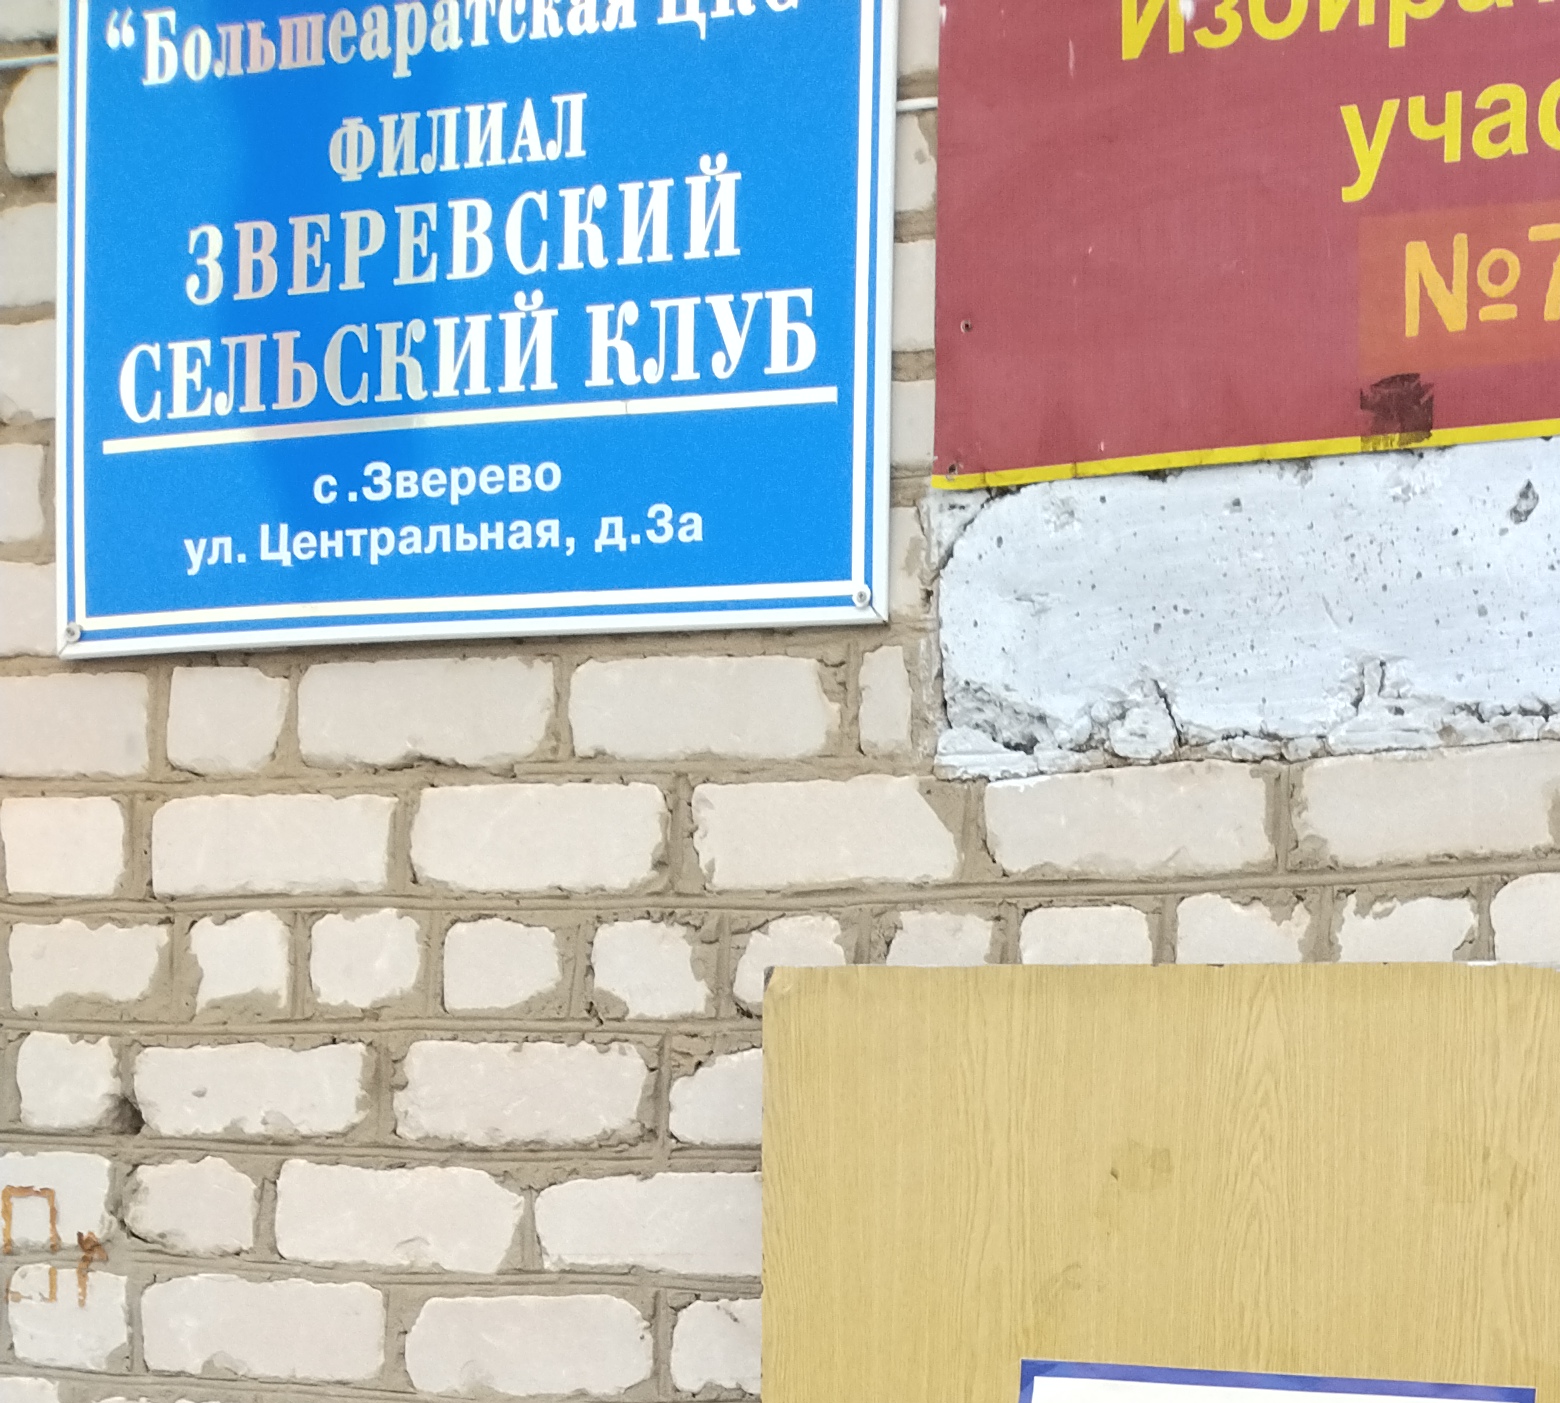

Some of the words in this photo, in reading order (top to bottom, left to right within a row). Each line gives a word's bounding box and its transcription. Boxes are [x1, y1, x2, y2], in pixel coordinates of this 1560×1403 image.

[328, 92, 588, 182] ФИЛИАЛ
[185, 152, 743, 306] ЗВЕРЕВСКИЙ
[118, 290, 560, 424] СЕЛЬСКИЙ
[584, 288, 818, 388] КЛУБ
[184, 535, 248, 576] ул.
[259, 517, 577, 567] Центральная,
